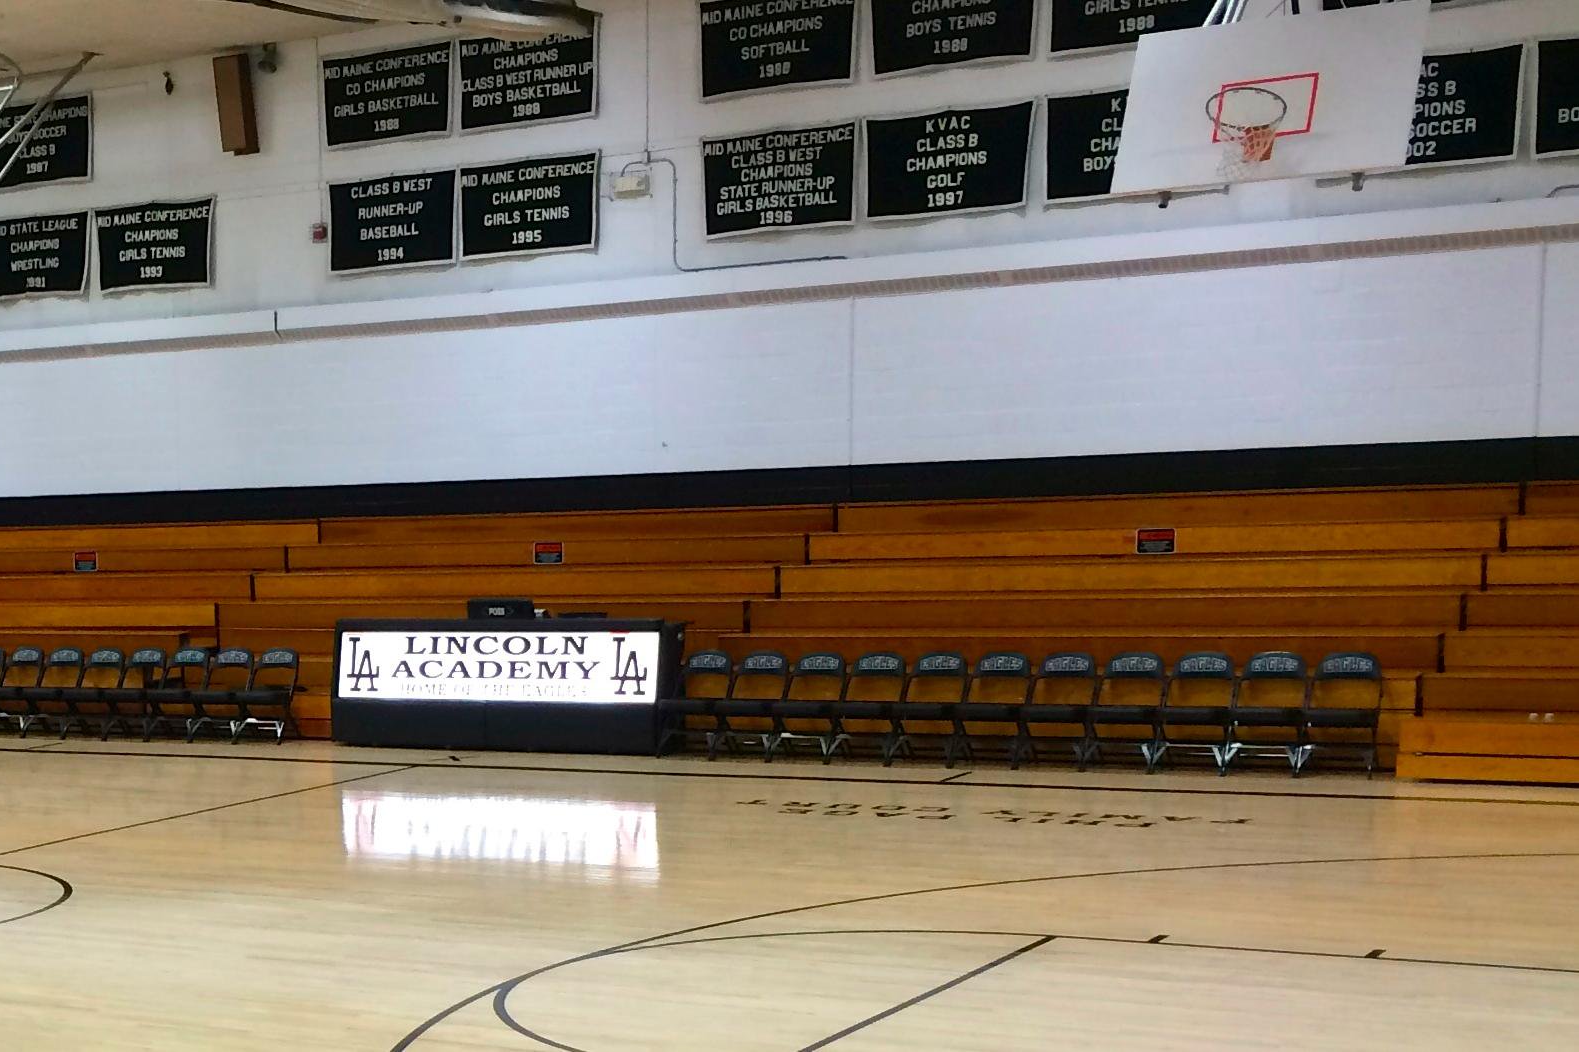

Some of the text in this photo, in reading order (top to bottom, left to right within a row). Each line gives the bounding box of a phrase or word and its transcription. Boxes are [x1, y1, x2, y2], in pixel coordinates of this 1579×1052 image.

[730, 16, 822, 41] CO CHAMPIONS
[906, 12, 996, 37] BOYS TENNIS
[494, 49, 558, 70] CHAMPIONS
[741, 40, 809, 60] SOFTBALL
[376, 50, 448, 72] CONFERENCE
[346, 73, 425, 95] CO CHAMPIONS
[462, 62, 594, 92] CLASS B WEST RUNNER UP
[473, 82, 580, 107] BOYS BASKETBALL
[1445, 80, 1456, 95] B
[334, 92, 438, 117] GIRLS BASKETBALL
[766, 126, 852, 150] CONFERENCE
[916, 134, 977, 152] CLASS B
[732, 147, 822, 169] CLASS B WEST
[907, 151, 987, 171] CHAMPIONS
[519, 161, 595, 181] CONFERENCE
[741, 163, 812, 182] CHAMPIONS
[927, 172, 966, 188] GOLF
[351, 178, 432, 198] CLASS B WEST
[493, 186, 560, 204] CHAMPIONS
[720, 176, 834, 199] STATE RUNNER-UP
[717, 190, 837, 216] GIRLS BASKETBALL
[927, 190, 963, 206] 1997
[145, 206, 209, 221] CONFERENCE
[358, 202, 423, 219] RUNNER-UP
[484, 207, 569, 226] GIRLS TENNIS
[760, 210, 792, 225] 1996
[10, 222, 39, 235] STATE
[43, 218, 78, 231] LEAGUE
[125, 229, 178, 243] CHAMPIONS
[360, 223, 418, 240] BASEBALL
[11, 239, 59, 253] CHAMPIONS
[512, 231, 542, 244] 1995
[120, 246, 185, 262] GIRLS TENNIS
[378, 247, 403, 260] 1994
[11, 257, 59, 272] WRESTLING
[140, 266, 162, 278] 1993
[405, 636, 588, 655] LINCOLN
[392, 660, 600, 679] ACADEMY
